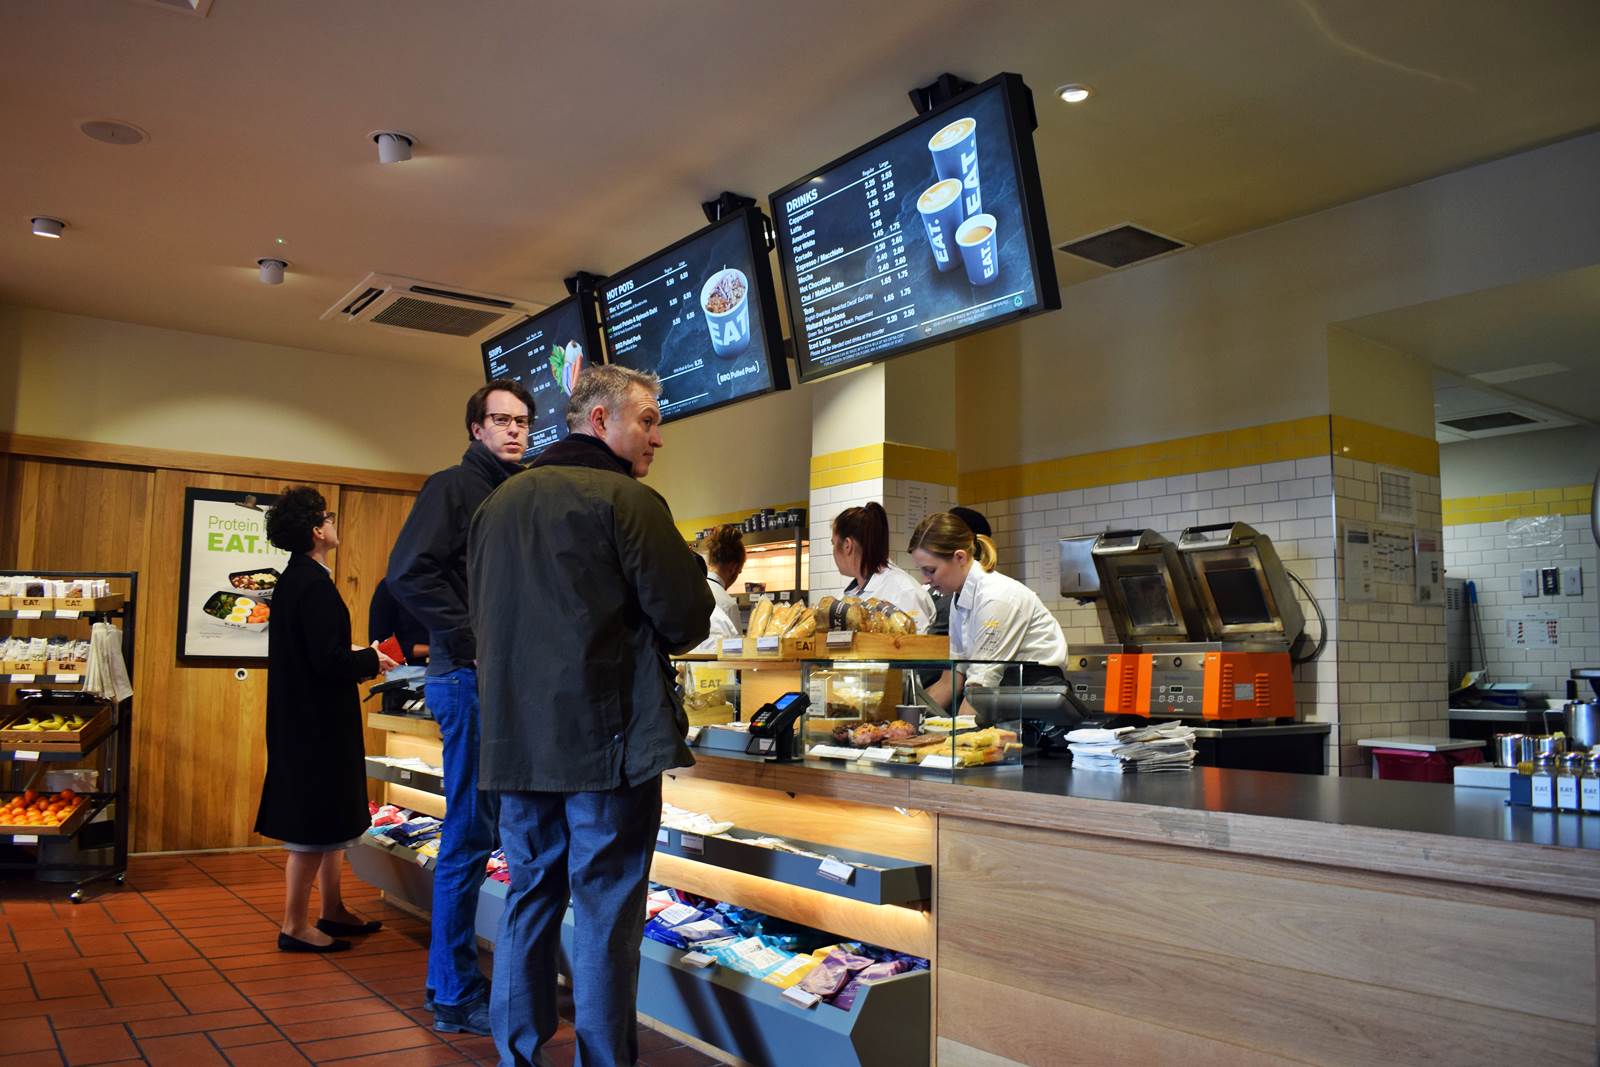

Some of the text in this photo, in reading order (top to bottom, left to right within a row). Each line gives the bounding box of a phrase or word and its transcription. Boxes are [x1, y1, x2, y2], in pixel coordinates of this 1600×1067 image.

[961, 138, 981, 216] EAT.
[786, 188, 819, 213] DRINKS
[928, 218, 949, 262] EAT.
[980, 240, 994, 279] EAT.
[606, 279, 634, 300] HOT POTS
[208, 515, 259, 532] Protein
[58, 663, 77, 671] EAT.
